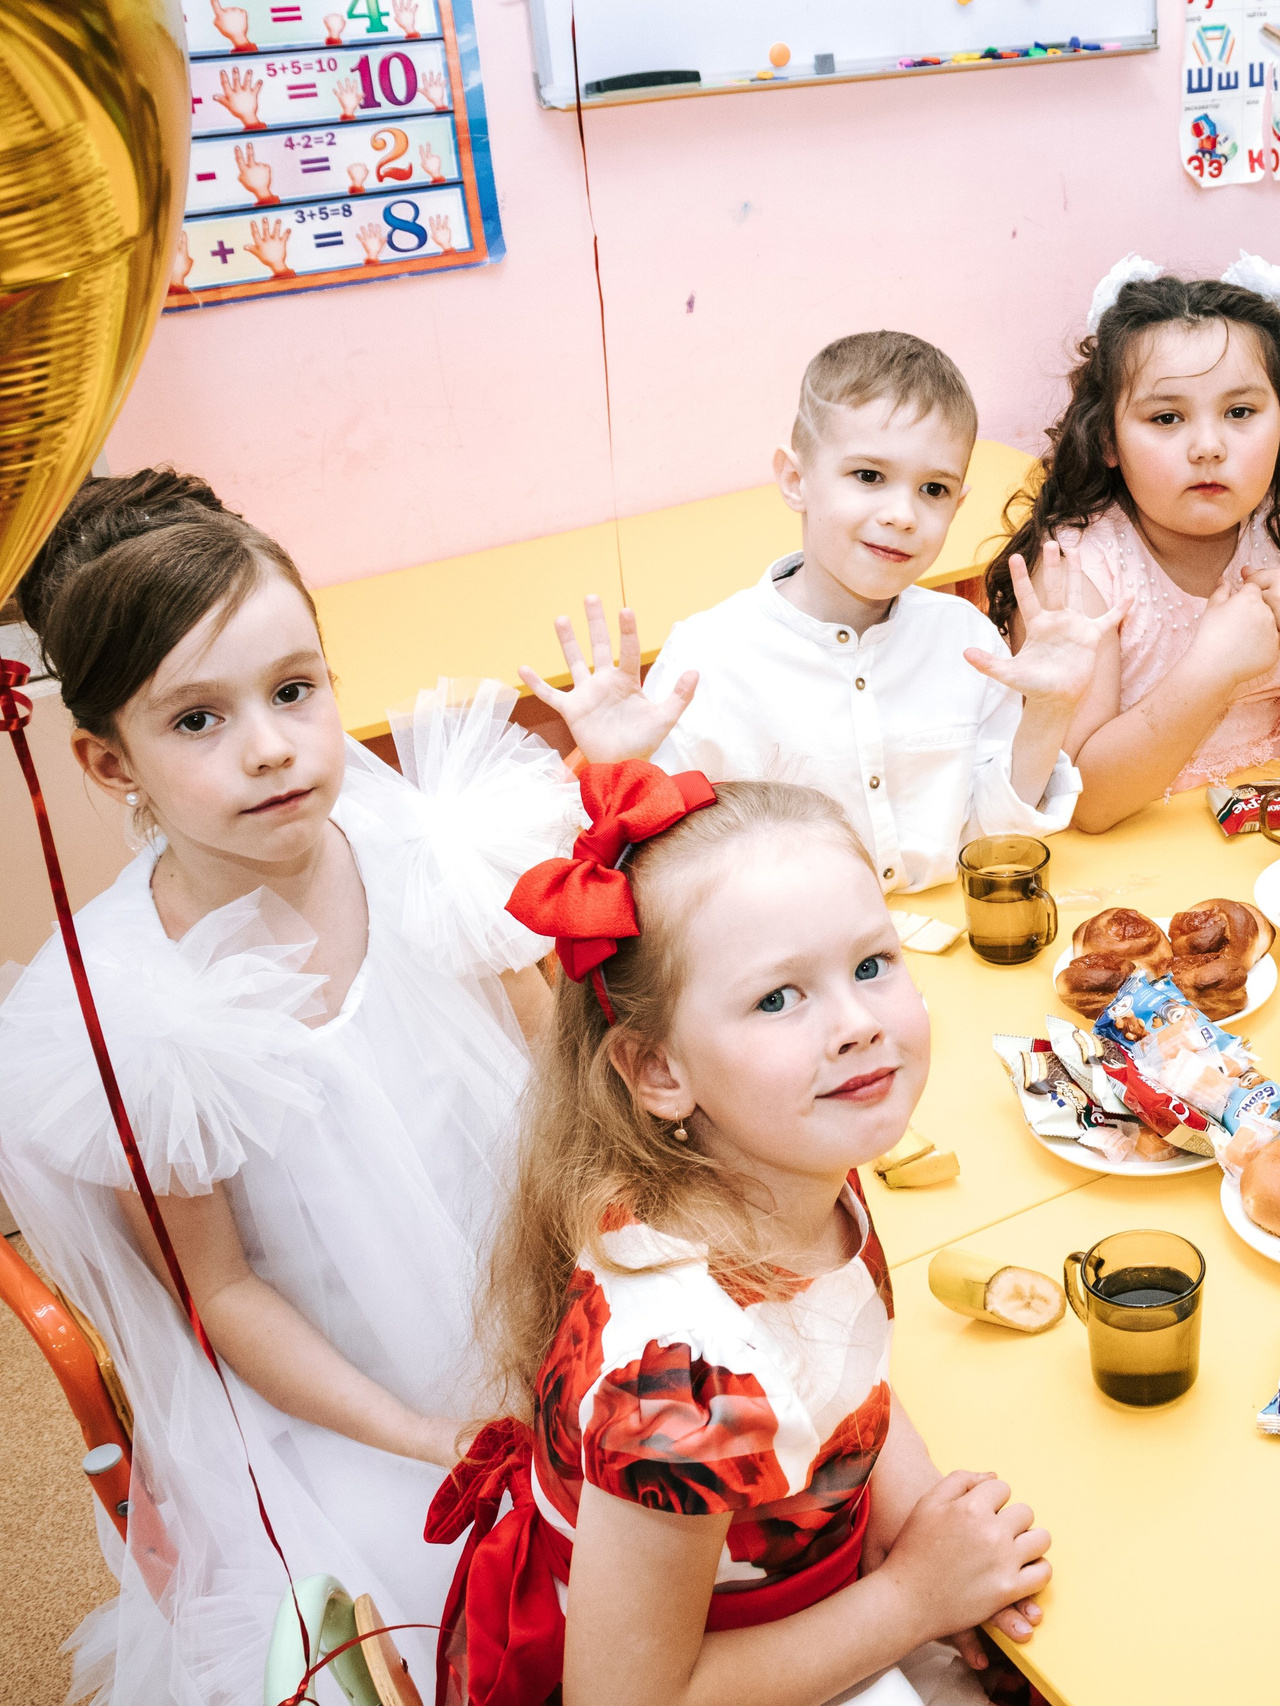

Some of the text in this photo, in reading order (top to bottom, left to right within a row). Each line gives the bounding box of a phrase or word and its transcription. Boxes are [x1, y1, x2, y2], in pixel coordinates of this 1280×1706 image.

[347, 0, 390, 33] 4
[265, 57, 338, 77] 5+5=10
[350, 51, 418, 109] 10
[283, 132, 337, 150] 4-2=2
[370, 127, 413, 183] 2
[294, 203, 353, 224] 3+5=8
[383, 199, 428, 252] 8
